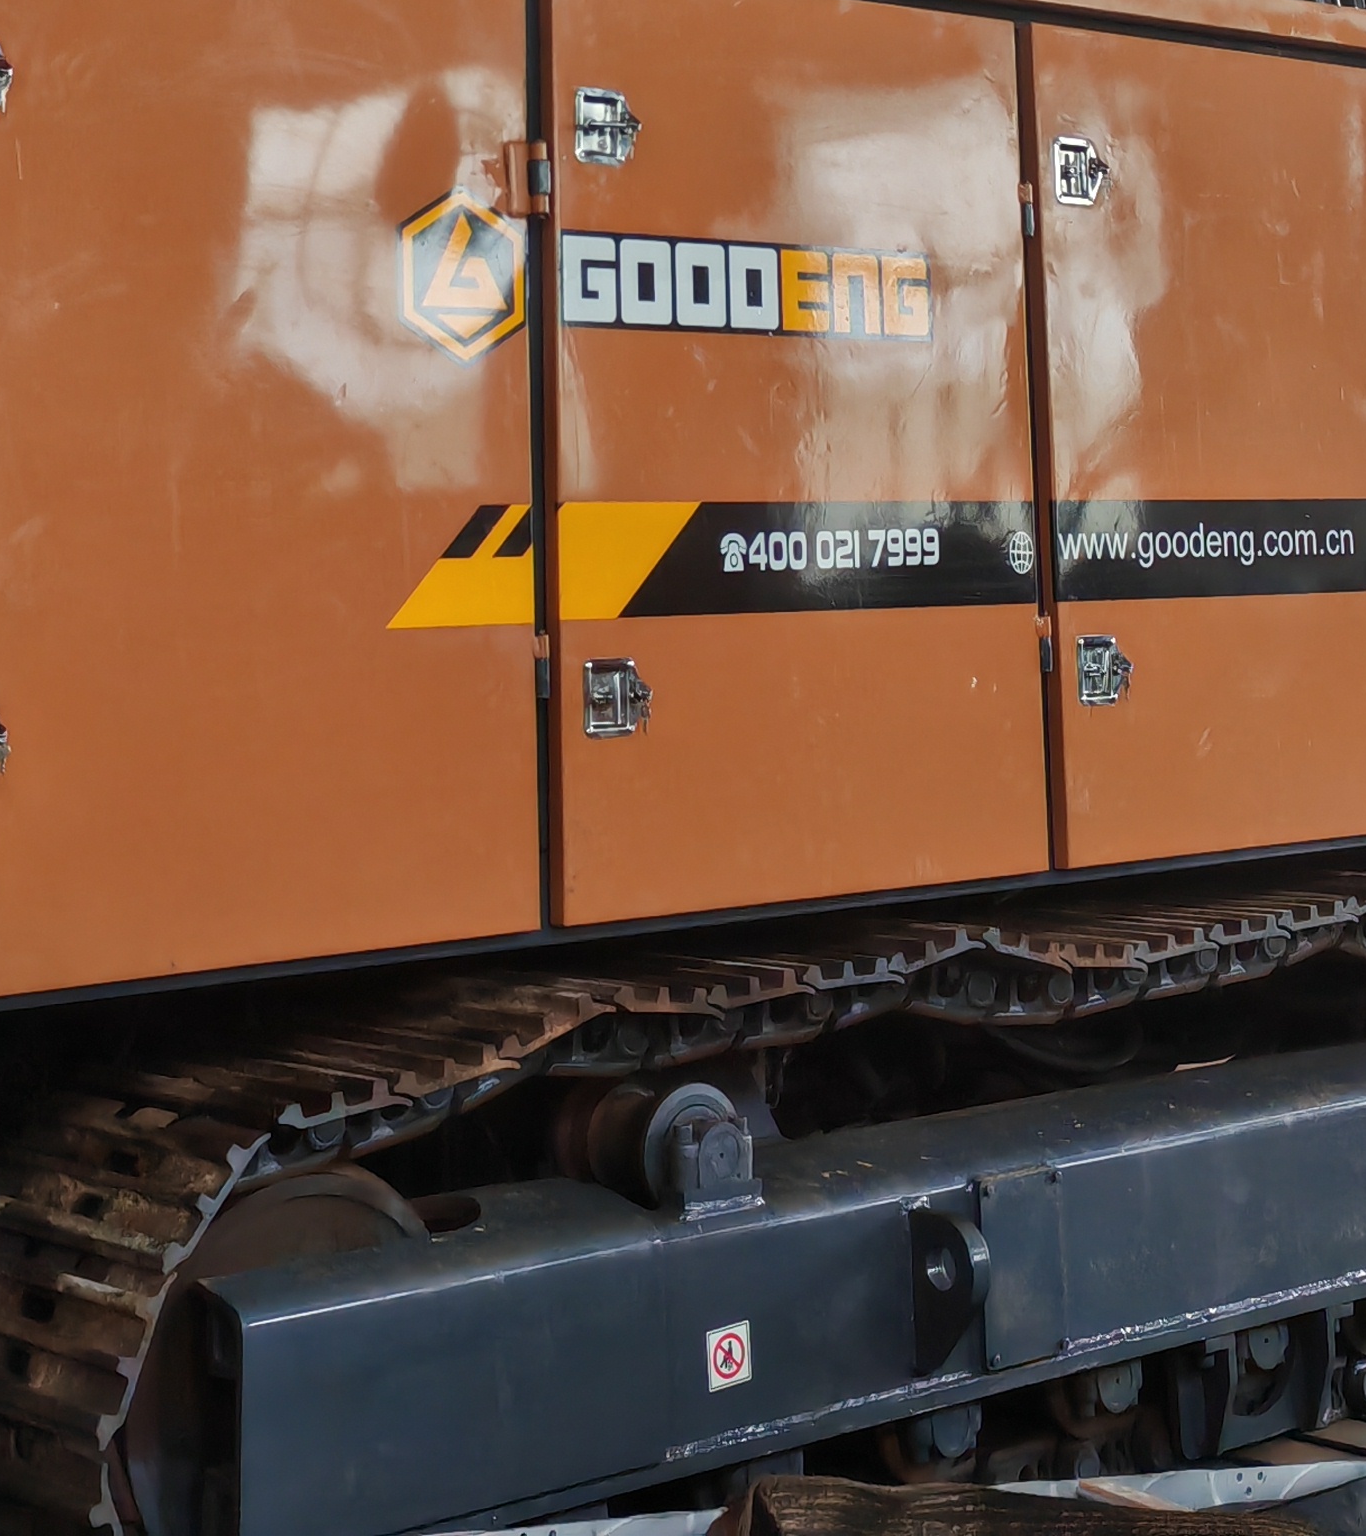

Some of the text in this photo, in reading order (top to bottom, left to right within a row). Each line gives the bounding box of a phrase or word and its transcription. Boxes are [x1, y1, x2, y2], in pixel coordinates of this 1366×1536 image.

[748, 528, 939, 571] 400 021 7999
[1059, 522, 1355, 568] www.goodeng.com.cn
